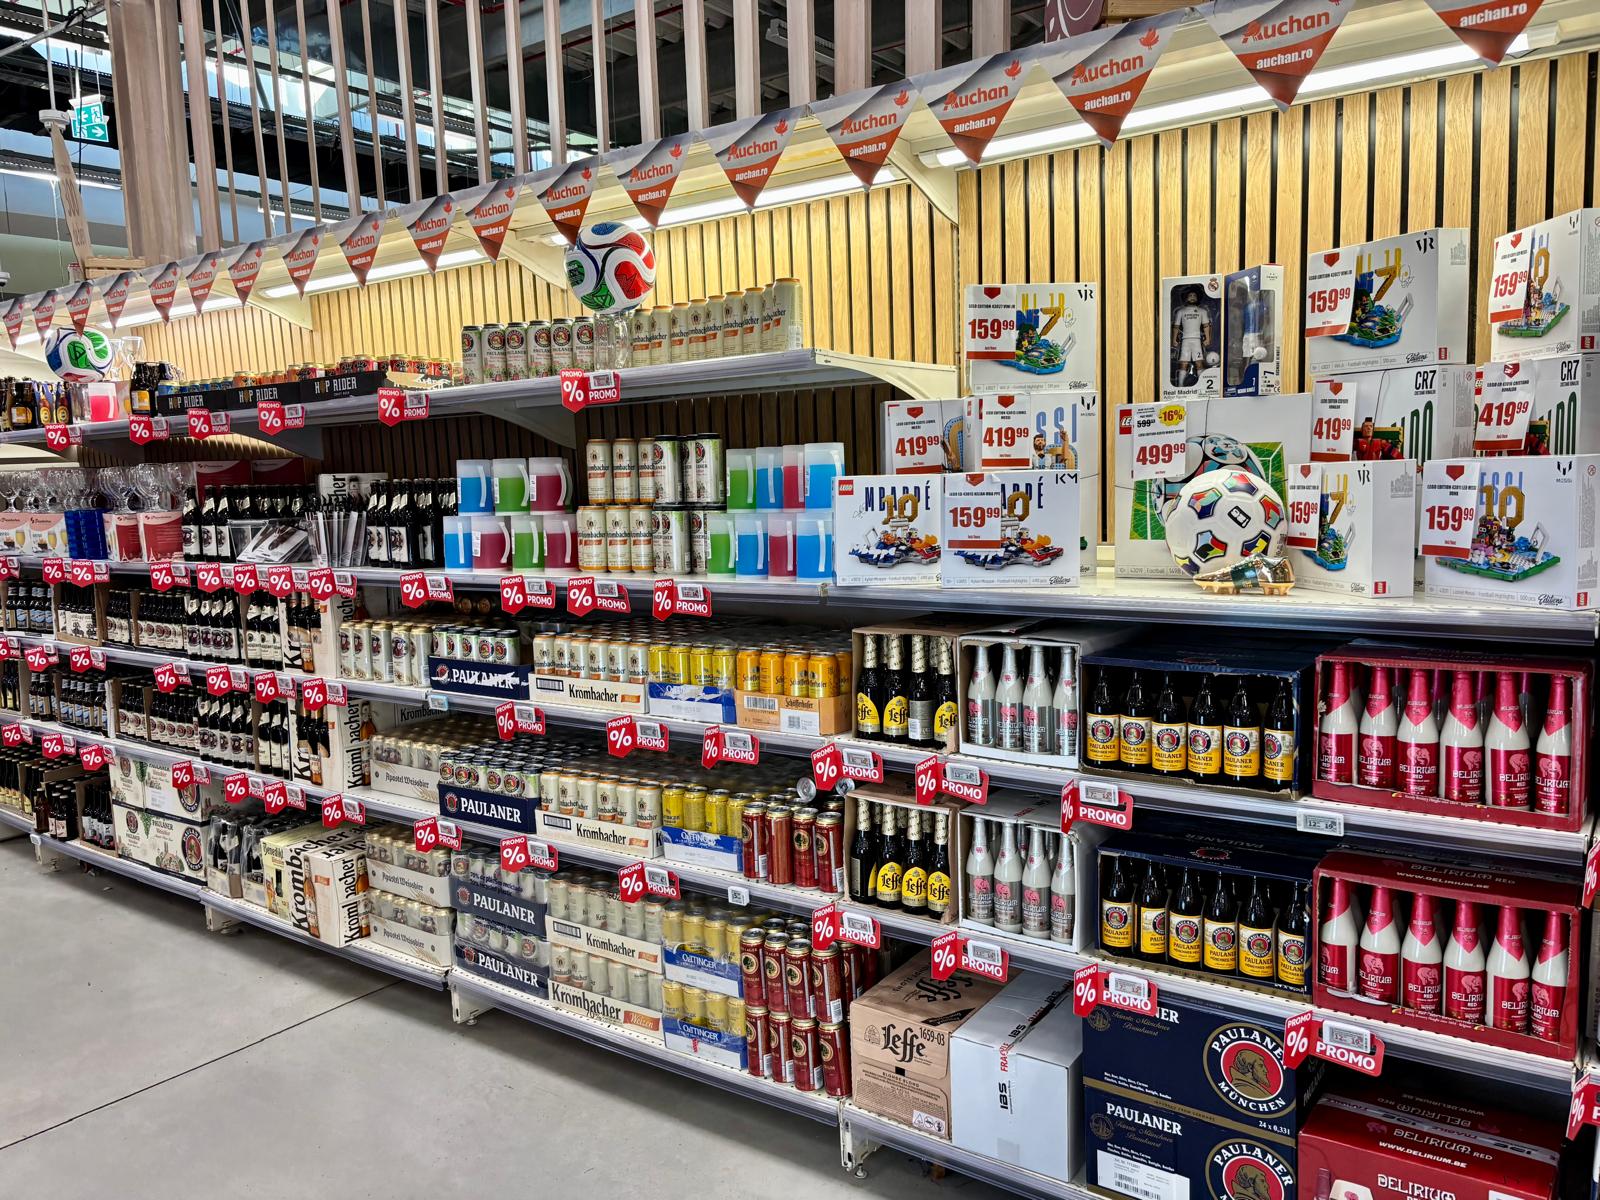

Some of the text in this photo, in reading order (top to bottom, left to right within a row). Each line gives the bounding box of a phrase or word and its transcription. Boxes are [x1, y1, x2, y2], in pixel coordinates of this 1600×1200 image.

[1460, 3, 1528, 27] auchan.ro
[1241, 9, 1330, 43] Auchan
[1256, 48, 1313, 70] auchan.ro
[1071, 55, 1144, 86] Auchan
[943, 83, 1008, 111] Auchan
[1085, 90, 1131, 111] auchan.ro
[840, 112, 897, 136] Auchan
[954, 115, 996, 133] auchan.ro
[727, 138, 777, 161] Auchan
[850, 142, 887, 157] auchan.ro
[630, 163, 673, 183] Auchan
[735, 167, 768, 181] auchan.ro
[546, 184, 586, 202] Auchan
[638, 188, 667, 201] auchan.ro
[474, 202, 510, 219] Auchan
[555, 209, 581, 221] auchan.ro
[416, 217, 447, 233] Auchan
[481, 225, 504, 236] auchan.ro
[346, 234, 375, 250] Auchan
[422, 239, 442, 250] auchan.ro
[288, 248, 314, 263] Auchan
[233, 259, 258, 273] Auchan
[191, 268, 213, 283] Auchan
[1560, 360, 1580, 381] CR7
[333, 376, 358, 392] RIDER
[1206, 379, 1214, 390] 2
[1414, 370, 1437, 390] CR7
[256, 386, 278, 401] RIDER
[589, 388, 617, 400] PROMO
[184, 395, 204, 408] RIDER
[404, 406, 427, 417] PROMO
[1055, 472, 1078, 484] KM
[655, 580, 673, 588] PROMO
[429, 590, 452, 599] PROMO
[527, 596, 553, 605] PROMO
[597, 600, 627, 611] PROMO
[676, 602, 709, 614] PROMO
[569, 684, 619, 703] Krombacher
[497, 703, 513, 712] PROMO
[518, 721, 543, 732] PROMO
[608, 717, 631, 727] PROMO
[705, 727, 720, 735] PROMO
[637, 737, 666, 748] PROMO
[722, 749, 755, 761] PROMO
[813, 746, 834, 760] PROMO
[1154, 752, 1182, 760] PAULANER
[842, 766, 879, 779] PROMO
[917, 759, 936, 772] PROMO
[941, 780, 982, 799] PROMO
[461, 797, 521, 824] PAULANER
[1080, 806, 1126, 825] PROMO
[415, 819, 435, 828] PROMO
[502, 837, 525, 846] PROMO
[576, 823, 626, 845] Krombacher
[439, 837, 459, 848] PROMO
[530, 855, 555, 868] PROMO
[620, 864, 642, 876] PROMO
[648, 883, 677, 897] PROMO
[473, 892, 536, 925] PAULANER
[814, 906, 834, 918] PROMO
[839, 928, 877, 945] PROMO
[933, 933, 956, 947] PROMO
[586, 932, 636, 958] Krombacher
[478, 953, 539, 988] PAULANER
[962, 957, 1003, 977] PROMO
[1076, 966, 1097, 979] PROMO
[551, 982, 621, 1020] Krombacher
[1102, 991, 1151, 1011] PROMO
[1288, 1012, 1311, 1028] PROMO
[1008, 1023, 1026, 1038] IBS
[881, 1023, 945, 1063] Leffe 1659-03
[1316, 1041, 1375, 1070] PROMO
[998, 1082, 1009, 1110] IBS
[1218, 1081, 1287, 1112] MÜNCHEN
[1106, 1102, 1183, 1137] PAULANER
[1258, 1120, 1268, 1129] 24
[1394, 1128, 1493, 1161] DELIRIUM RED
[1379, 1140, 1468, 1169] WWW.DELIRIUM.BE
[1213, 1143, 1294, 1187] PAULANER
